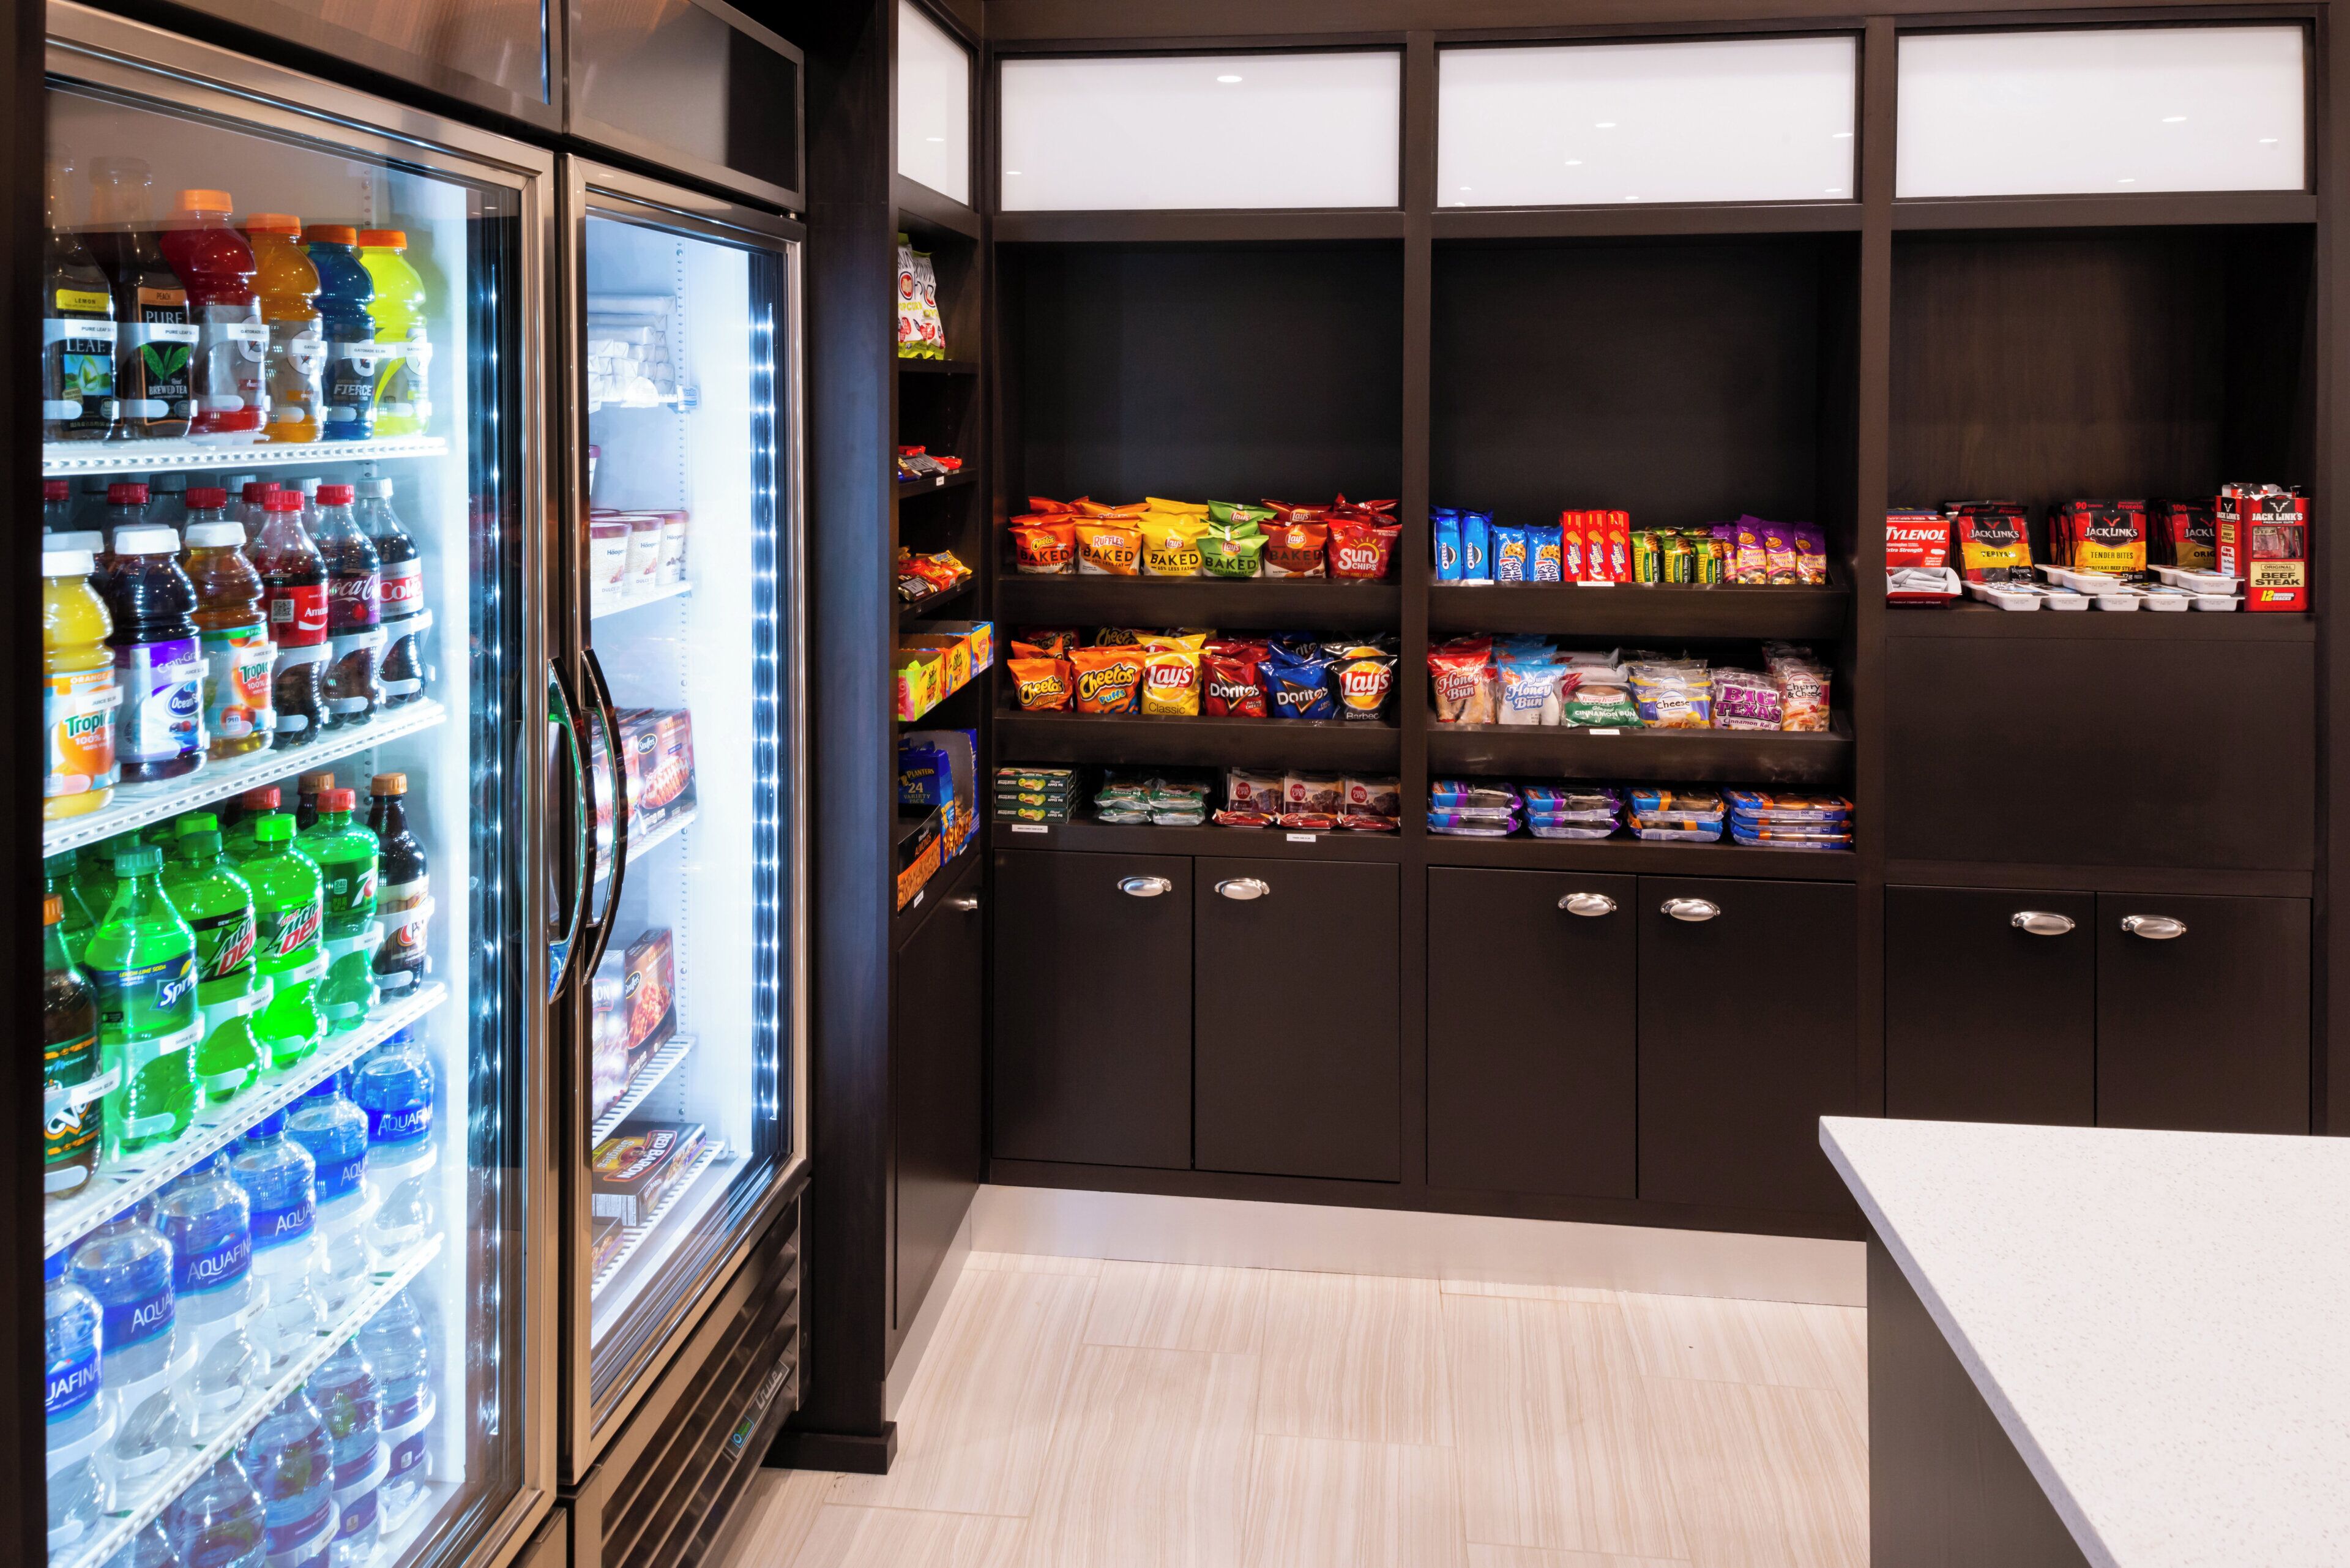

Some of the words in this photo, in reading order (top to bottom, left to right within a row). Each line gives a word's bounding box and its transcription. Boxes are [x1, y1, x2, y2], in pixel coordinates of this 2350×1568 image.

[146, 310, 183, 324] PURE
[65, 338, 105, 353] LEAF
[149, 386, 174, 395] BREWED
[175, 386, 188, 394] TEA
[334, 384, 372, 396] FIERCE
[1291, 512, 1310, 521] Lay's
[2275, 512, 2303, 521] LINK'S
[1886, 526, 1946, 541] TYLENOL
[1970, 529, 1993, 538] JACK
[1993, 530, 2020, 539] LINK'S
[2084, 527, 2110, 537] JACK
[2110, 528, 2138, 537] LINK'S
[2185, 528, 2209, 537] JACK
[1031, 536, 1055, 551] Cheetos
[1093, 536, 1124, 547] RUFFLES
[1166, 537, 1184, 548] Lay's
[1287, 534, 1305, 545] Lay's
[1223, 542, 1240, 552] Lay's
[1591, 544, 1603, 563] Butter
[1020, 550, 1069, 562] BAKED
[1083, 547, 1134, 562] BAKED
[1151, 553, 1199, 566] BAKED
[1270, 550, 1321, 561] BAKED
[1338, 548, 1379, 570] Sun
[1466, 542, 1475, 569] OREO
[1570, 545, 1581, 564] Butter
[1613, 545, 1625, 564] Butter
[1635, 548, 1643, 567] VALLEY
[1205, 556, 1257, 570] BAKED
[1351, 562, 1377, 570] CHIPS
[1567, 554, 1579, 574] Nutter
[1589, 553, 1602, 573] Nutter
[1611, 554, 1624, 574] Nutter
[2261, 590, 2275, 602] 12
[70, 673, 106, 684] ORANGE
[1078, 663, 1136, 700] Cheetos
[1147, 665, 1193, 689] Lay's
[1345, 672, 1391, 696] Lay's
[1439, 672, 1479, 692] Honey
[248, 680, 264, 689] 100%
[1019, 677, 1065, 705] Cheetos
[1210, 682, 1260, 698] Doritos
[1506, 682, 1553, 699] Honey
[1786, 682, 1821, 692] Cherry
[1098, 689, 1126, 704] Puffs
[1277, 685, 1328, 705] Doritos
[1447, 686, 1475, 701] Bun
[1723, 686, 1777, 707] BIG
[172, 697, 193, 709] Ocean
[1034, 696, 1058, 706] Crunchy
[1513, 696, 1542, 709] Bun
[1656, 699, 1690, 709] Cheese
[1149, 702, 1185, 715] Classic
[1715, 702, 1782, 722] TEXAS
[1723, 718, 1758, 726] Cinnamon
[75, 734, 101, 745] 100%
[639, 734, 657, 750] Stouffer's
[907, 768, 934, 778] PLANTERS
[908, 782, 924, 793] 24
[119, 968, 152, 977] LEMON-LIME
[654, 1133, 674, 1149] RED
[597, 1140, 635, 1168] Singles
[617, 1149, 664, 1179] BARON
